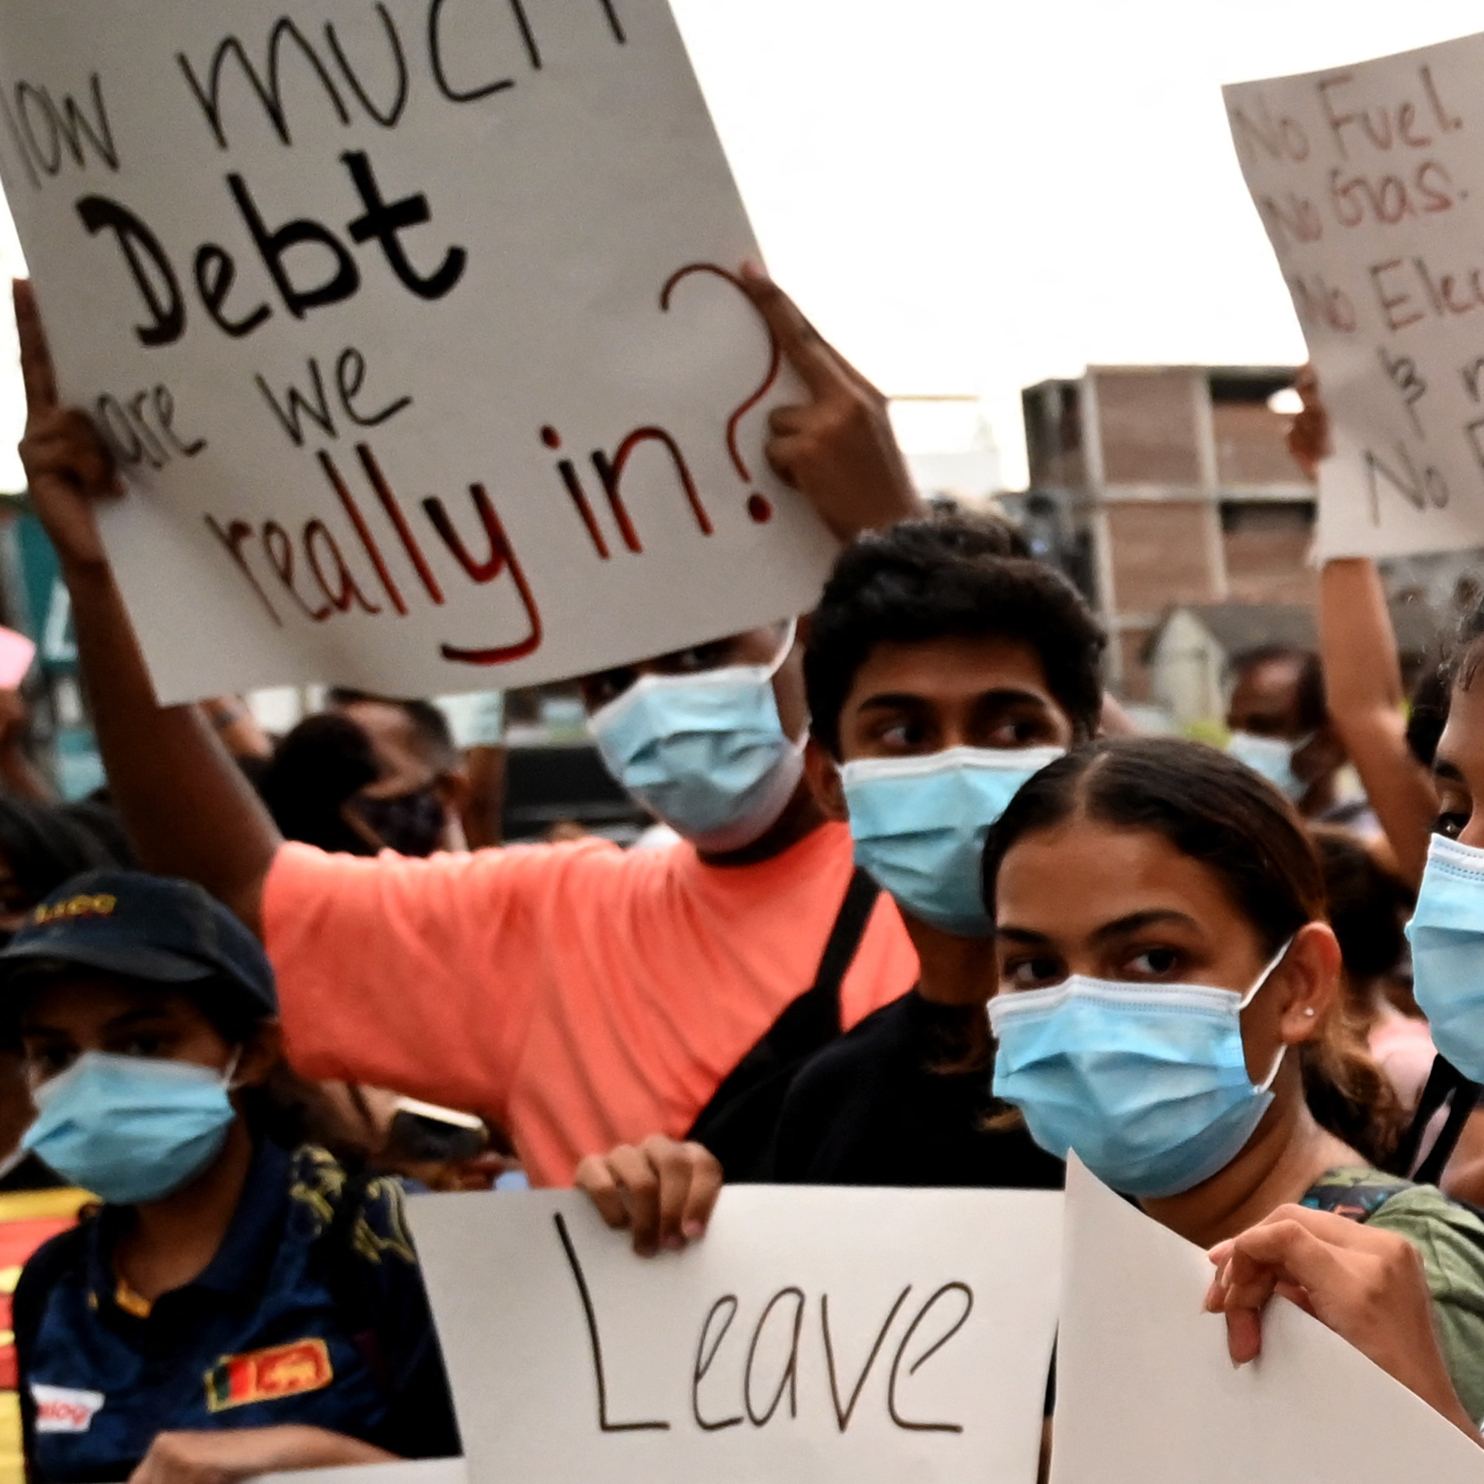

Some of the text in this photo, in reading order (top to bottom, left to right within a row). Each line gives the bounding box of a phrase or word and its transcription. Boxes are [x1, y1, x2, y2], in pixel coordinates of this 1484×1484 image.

[1233, 64, 1463, 165] No Fuel.
[76, 149, 467, 347] Debt
[1263, 161, 1469, 250] No Gas.
[1289, 272, 1356, 335] No
[97, 346, 412, 471] are we
[1363, 447, 1450, 528] No
[204, 444, 543, 665] really
[552, 1211, 974, 1433] Leave
